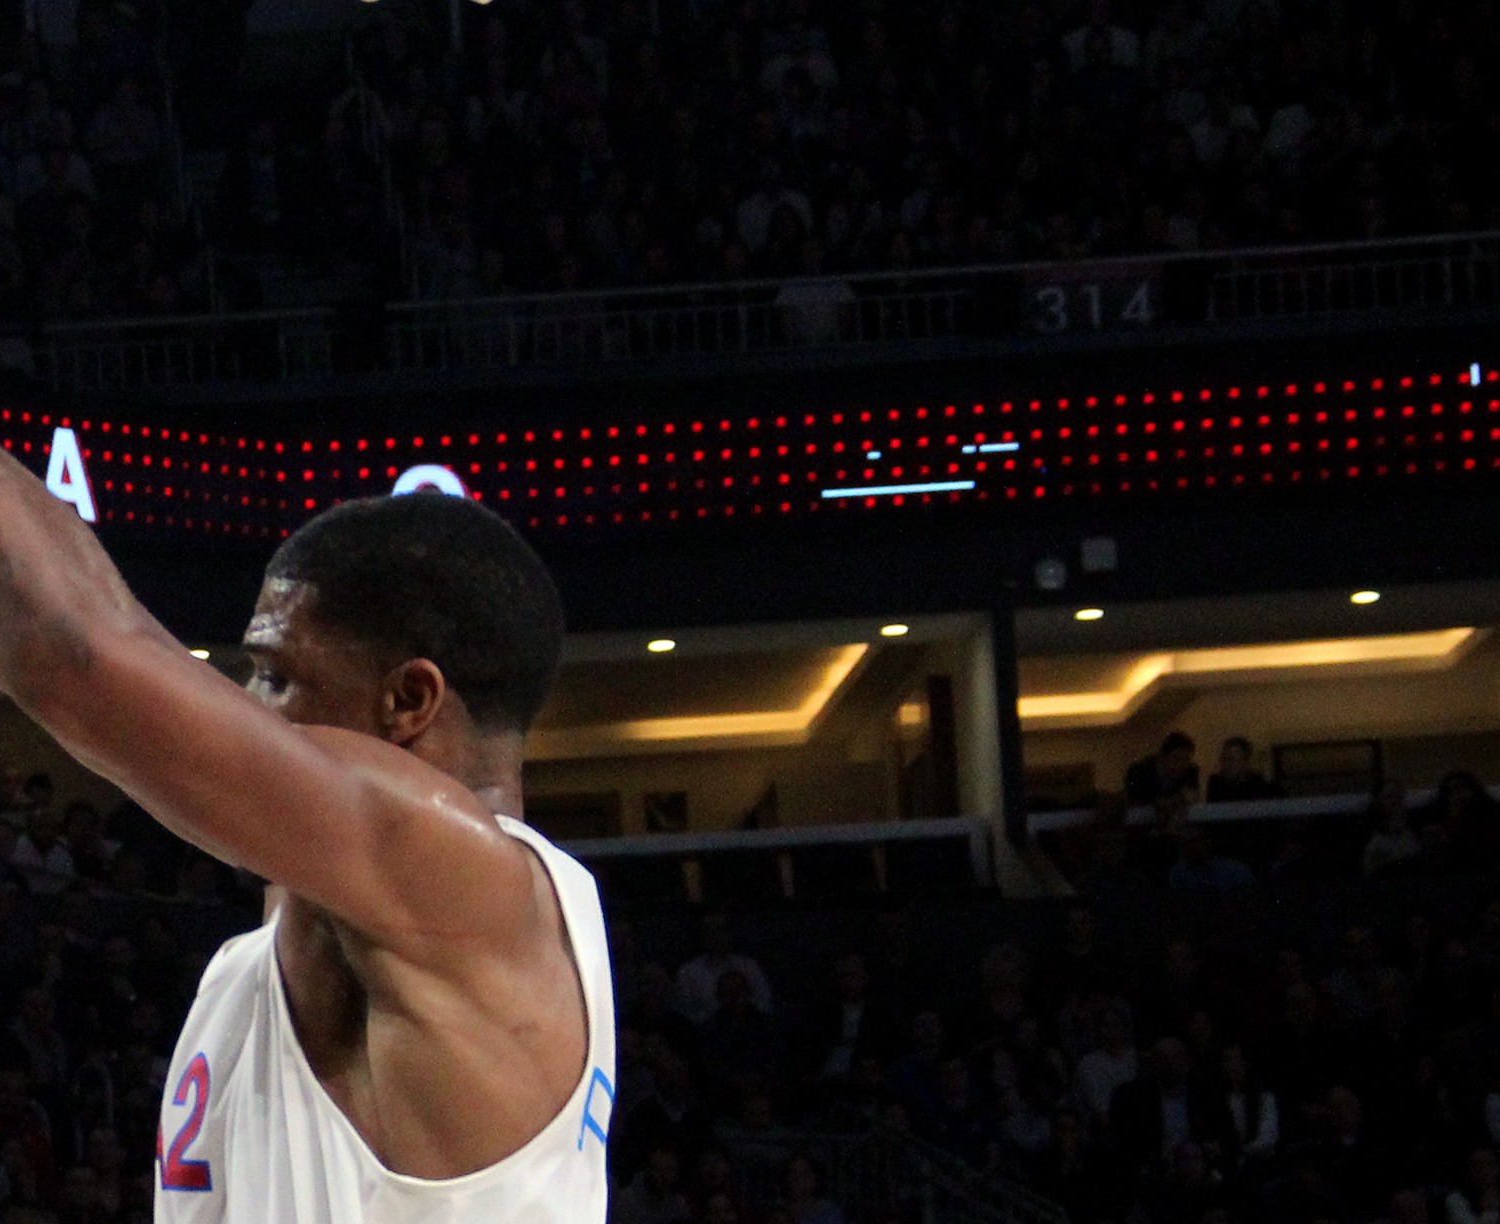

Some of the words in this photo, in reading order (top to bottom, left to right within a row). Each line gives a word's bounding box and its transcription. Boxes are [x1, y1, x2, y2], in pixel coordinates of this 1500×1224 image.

[1035, 282, 1154, 333] 314
[45, 426, 97, 523] A
[156, 1051, 212, 1192] 2
